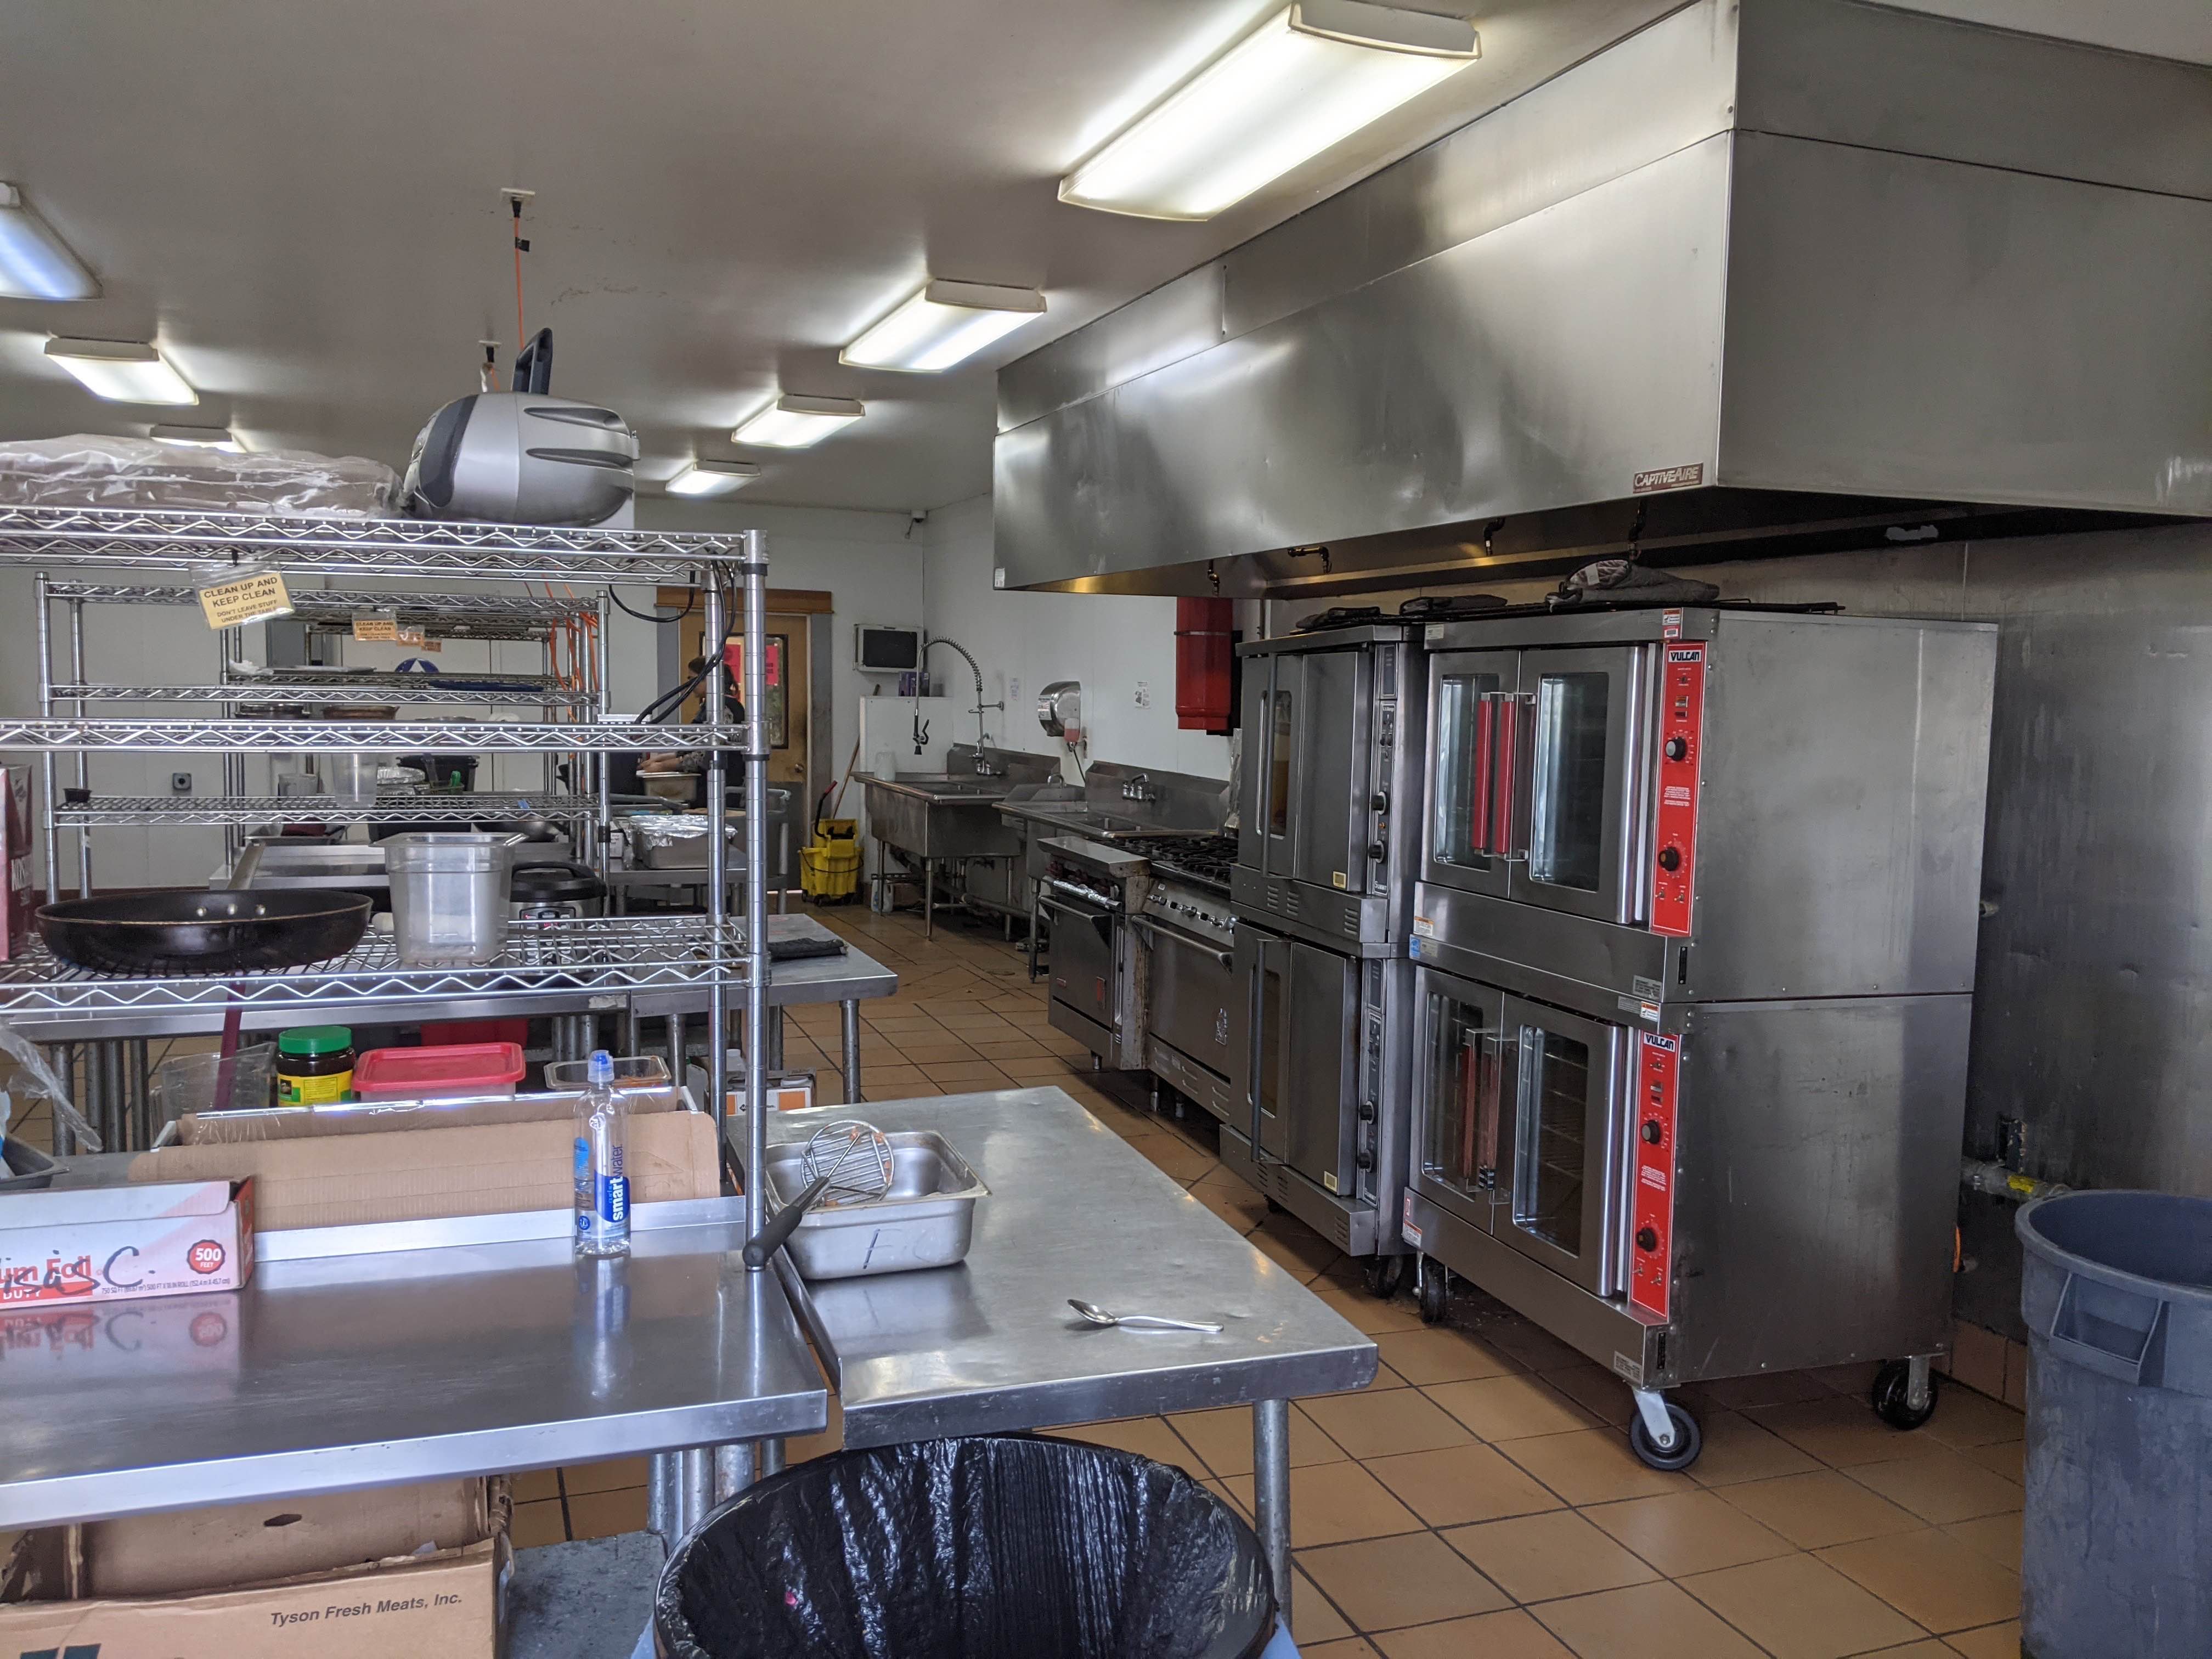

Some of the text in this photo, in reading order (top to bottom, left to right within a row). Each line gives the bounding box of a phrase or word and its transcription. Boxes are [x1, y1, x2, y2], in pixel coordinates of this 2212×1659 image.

[204, 577, 277, 598] CLEAN UP AND
[213, 588, 275, 607] KEEP CLEAN
[238, 605, 256, 613] LEAVE
[258, 600, 277, 608] STUFF
[222, 614, 244, 623] UNDER
[1670, 652, 1700, 661] VULCAN
[1646, 1035, 1673, 1050] VULCAN
[195, 1248, 222, 1261] 500
[271, 1594, 462, 1627] Tyson Fresh Meats, Inc.
